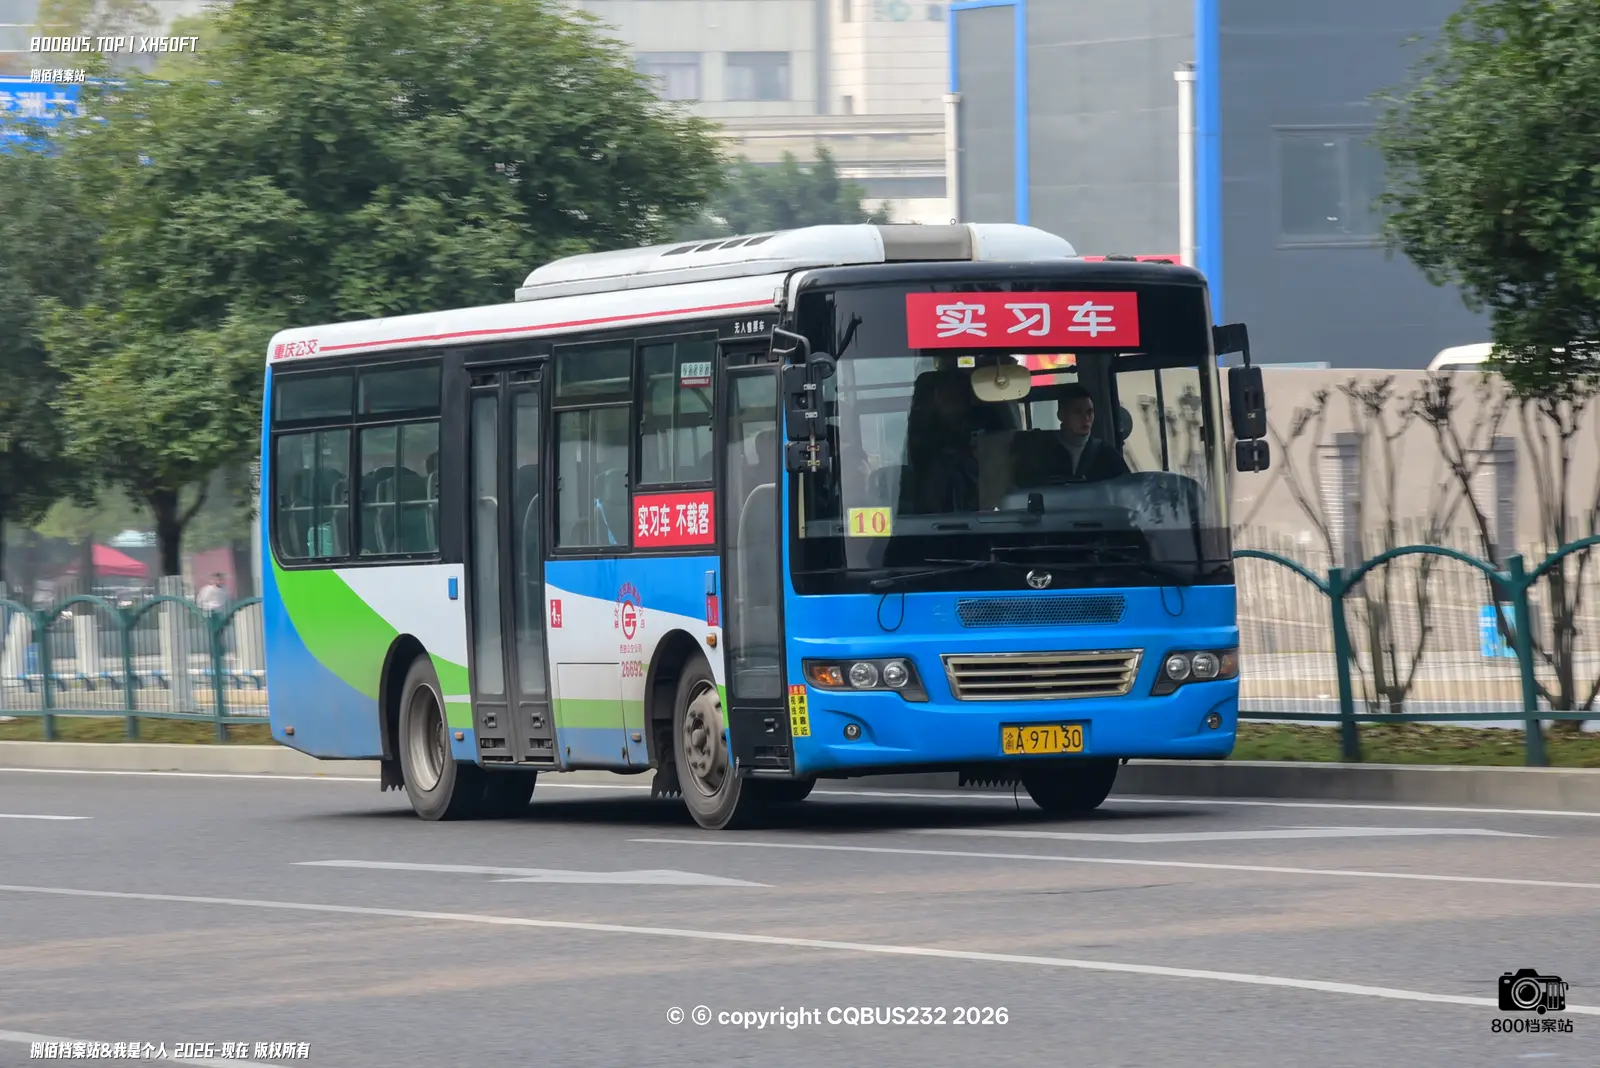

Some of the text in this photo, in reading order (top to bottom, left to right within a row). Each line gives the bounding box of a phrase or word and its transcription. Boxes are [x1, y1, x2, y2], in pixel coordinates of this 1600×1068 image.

[935, 301, 1117, 338] 实习车
[273, 339, 319, 359] 重庆公交
[638, 502, 709, 537] 实习车 不载客
[855, 511, 886, 534] 10
[621, 660, 643, 678] 26692
